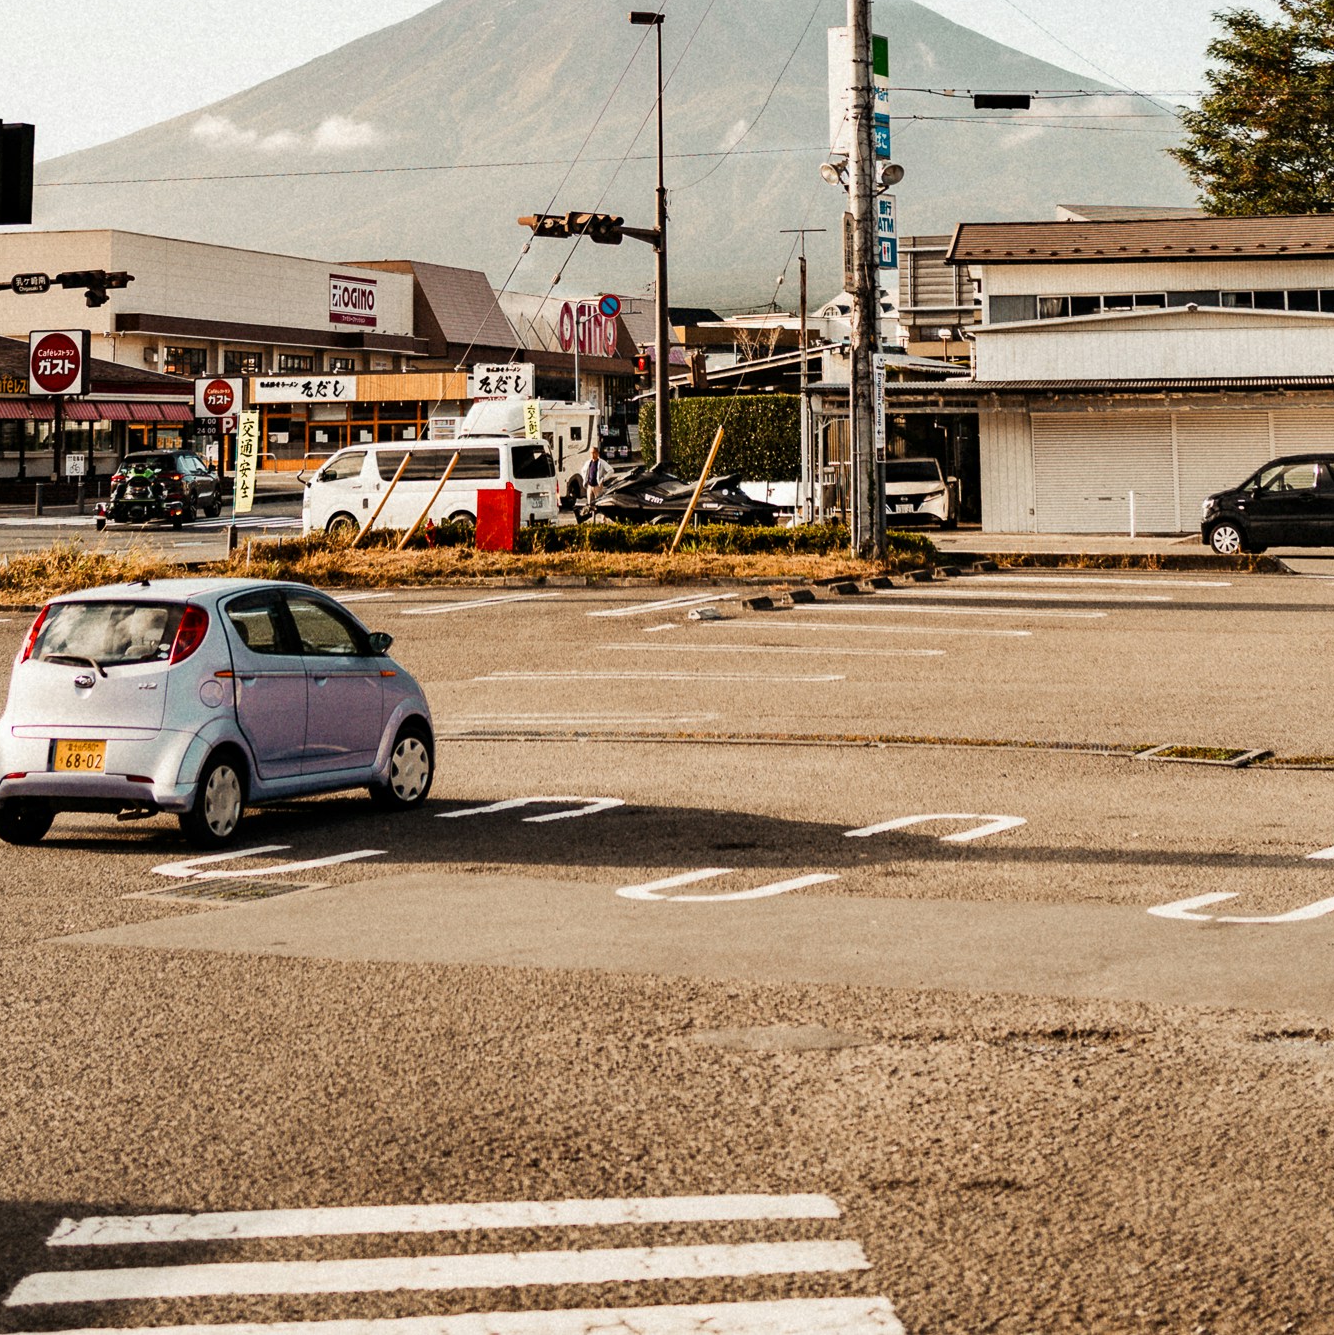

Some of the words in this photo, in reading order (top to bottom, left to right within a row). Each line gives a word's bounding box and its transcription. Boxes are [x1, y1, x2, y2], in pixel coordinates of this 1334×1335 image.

[878, 217, 894, 233] ATM
[342, 286, 375, 311] OGINO
[38, 359, 75, 375] ガスト
[207, 395, 231, 405] ガスト
[222, 418, 234, 434] P
[527, 405, 539, 440] 交通
[238, 418, 255, 499] 交通安全
[66, 753, 103, 768] 68-02
